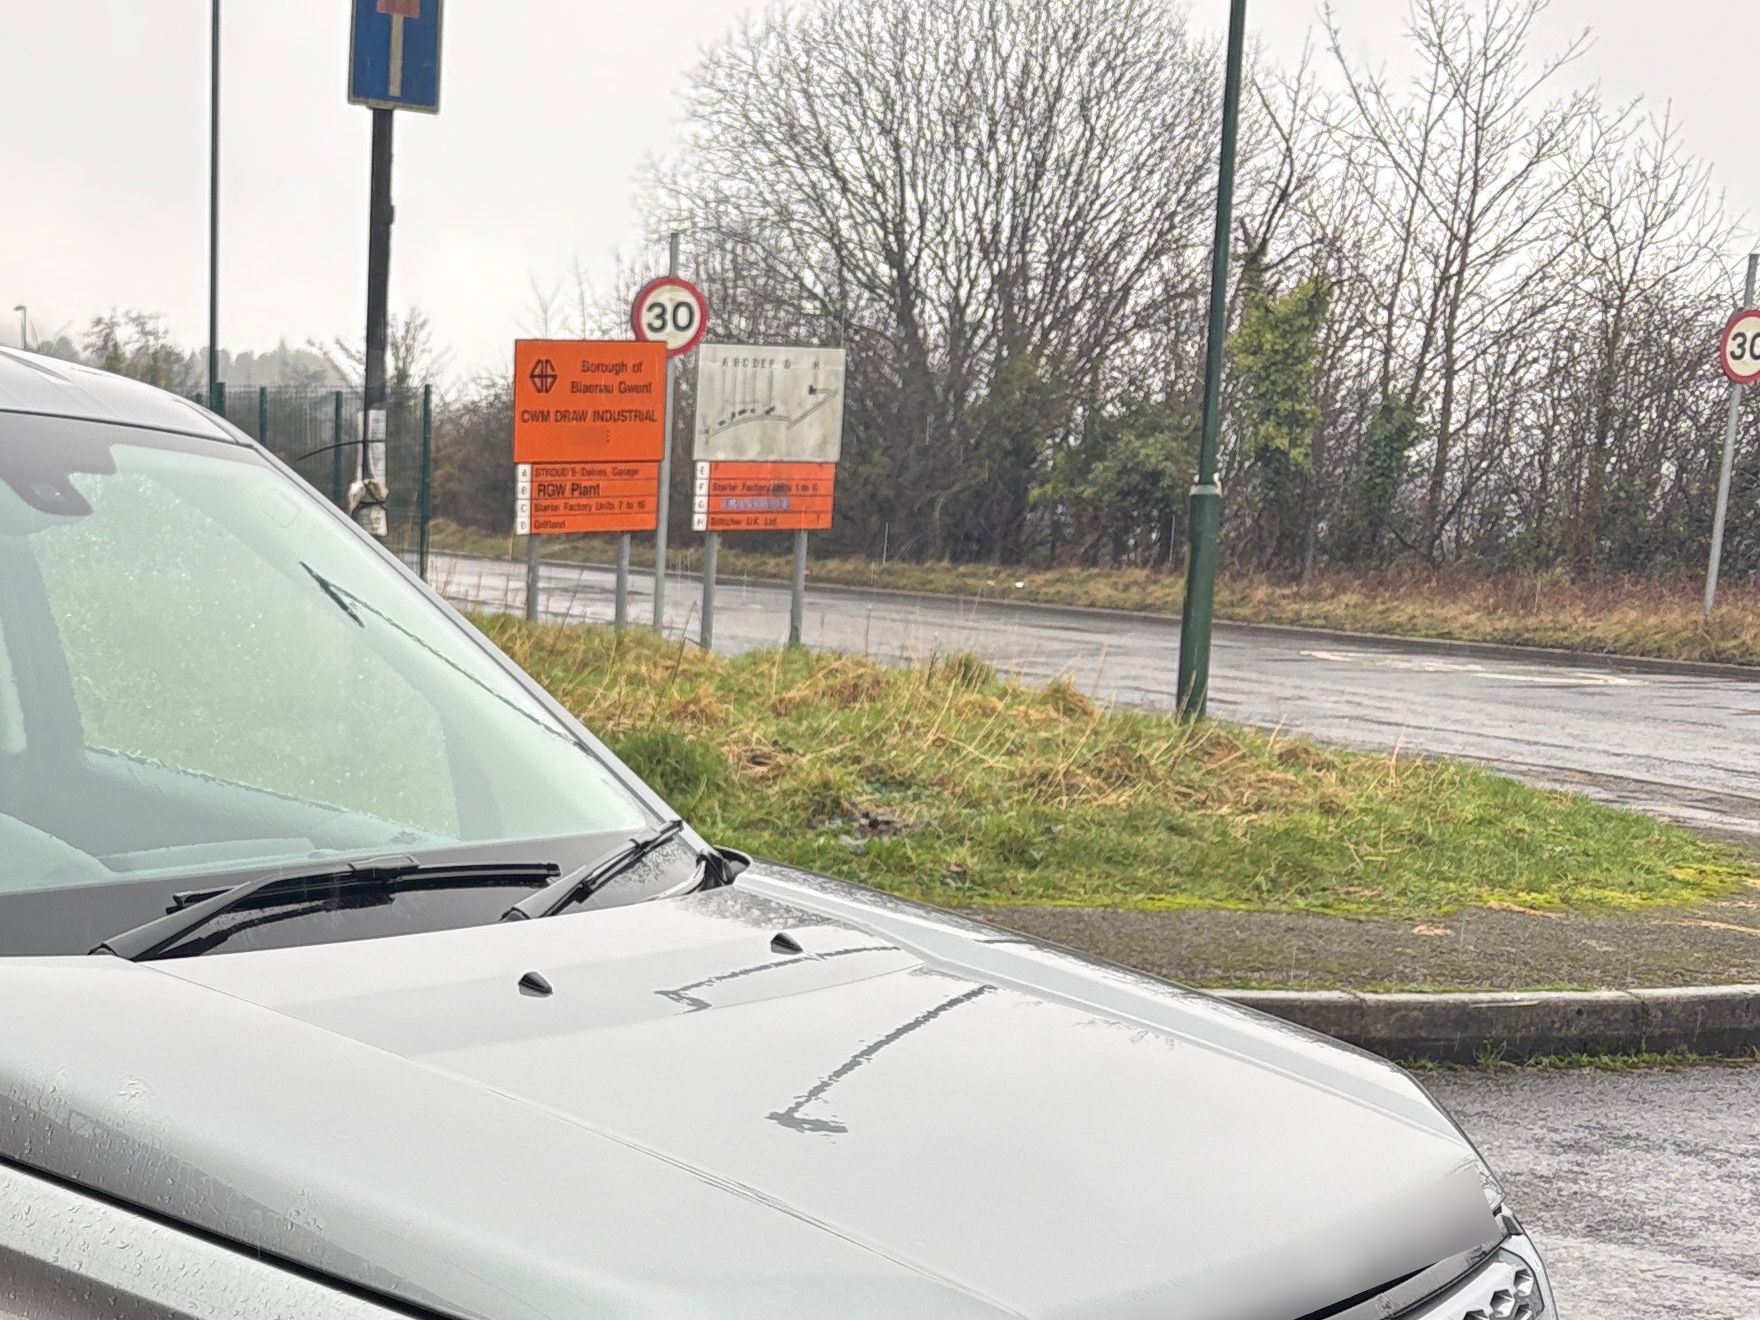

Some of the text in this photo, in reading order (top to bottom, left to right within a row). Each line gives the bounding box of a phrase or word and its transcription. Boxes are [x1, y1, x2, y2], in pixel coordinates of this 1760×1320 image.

[646, 301, 695, 333] 30
[581, 360, 643, 375] Borough of
[570, 381, 652, 394] Blaenau Gwent
[521, 409, 657, 423] CWM DRAW INDUSTRIAL
[537, 483, 567, 497] RGW
[571, 482, 600, 497] Plant
[564, 502, 592, 513] Factory
